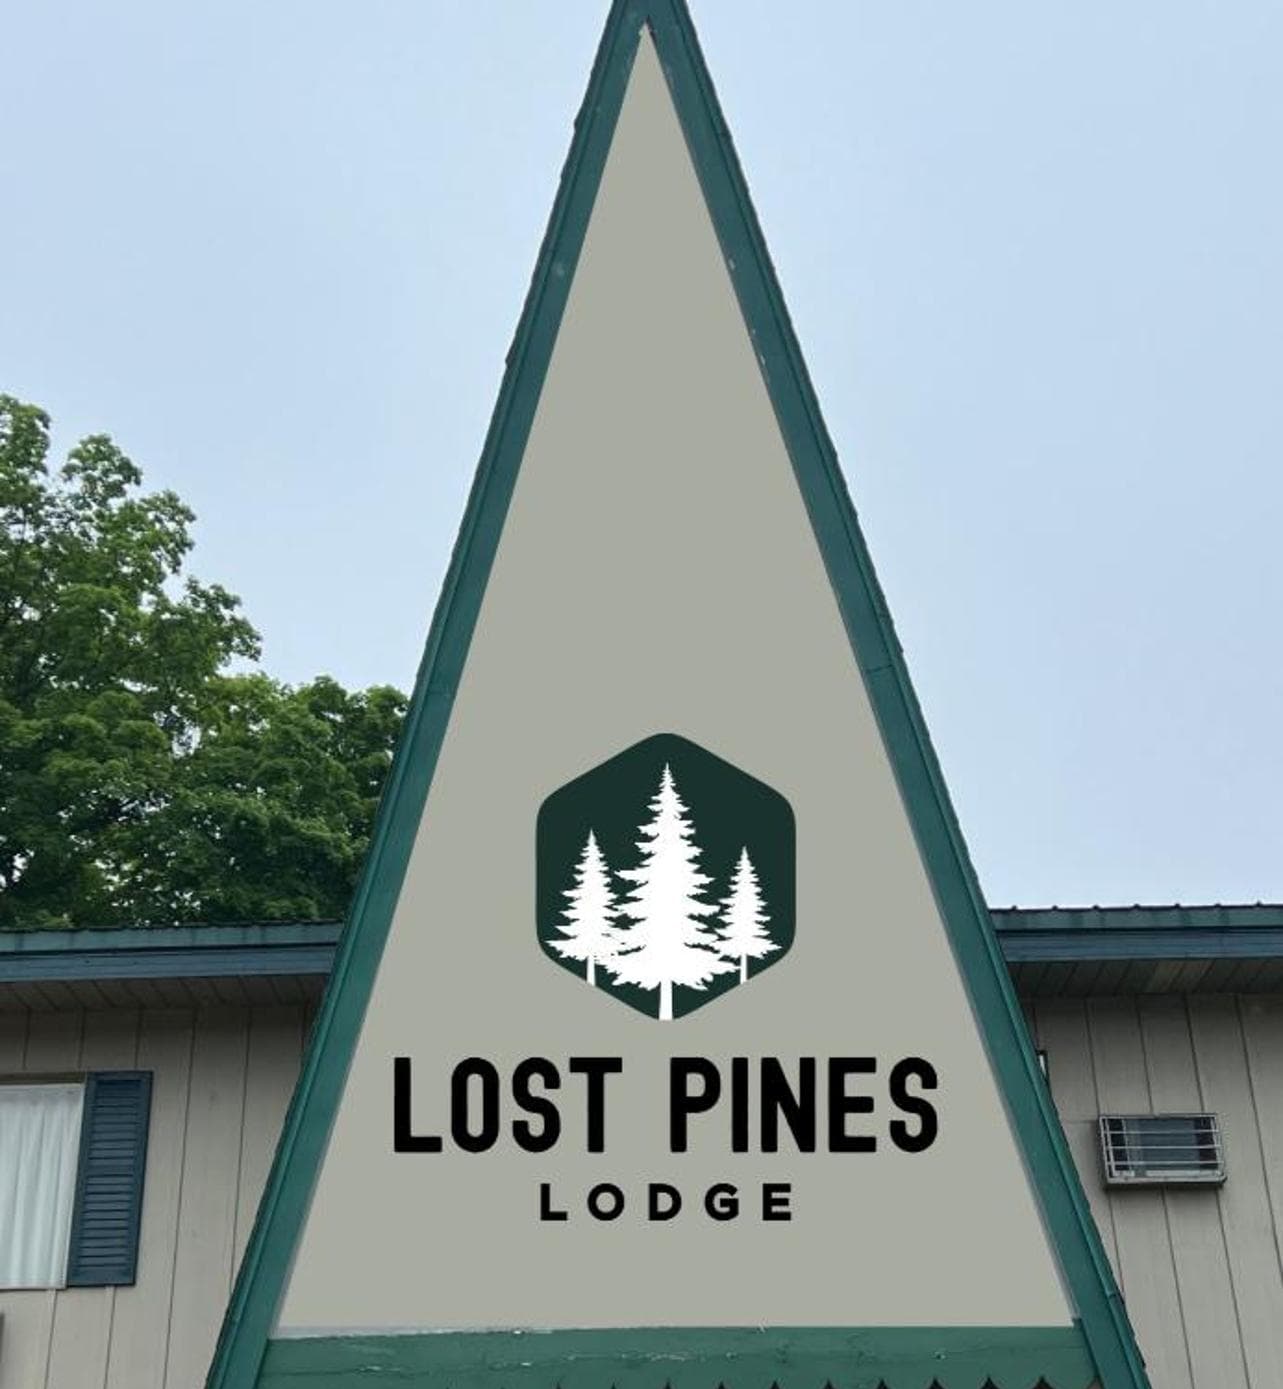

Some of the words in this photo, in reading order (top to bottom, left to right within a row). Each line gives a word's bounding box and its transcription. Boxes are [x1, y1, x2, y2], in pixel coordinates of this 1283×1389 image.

[393, 1056, 623, 1154] LOST
[669, 1056, 938, 1154] PINES
[540, 1182, 792, 1222] LODGE
